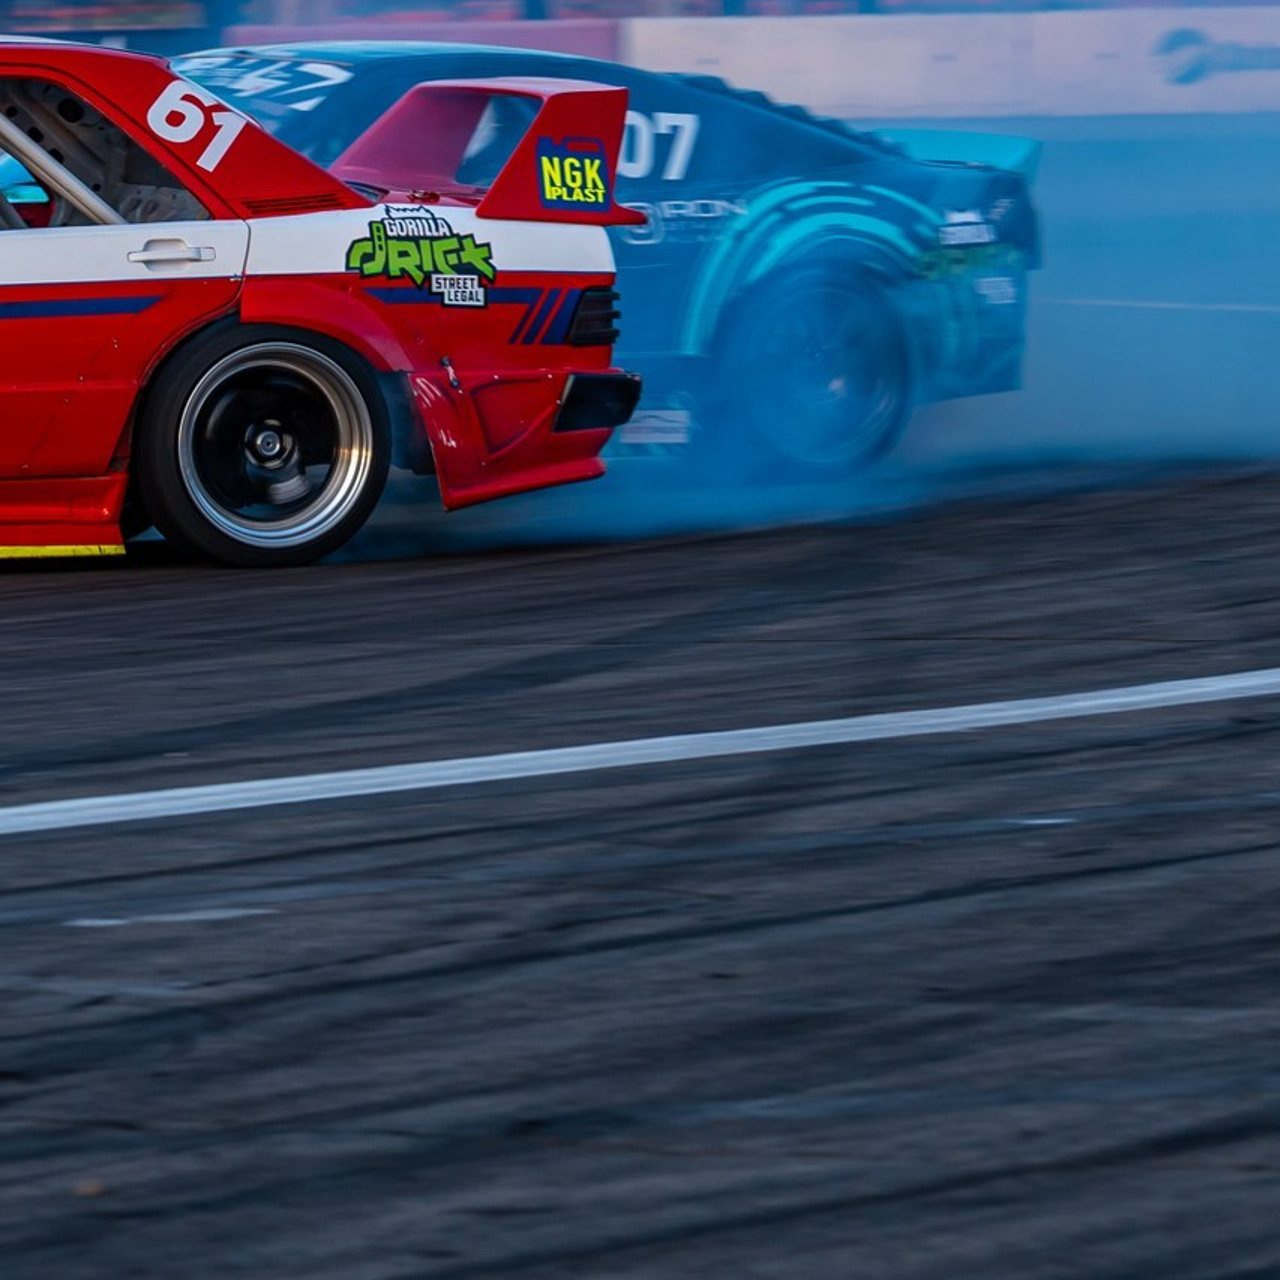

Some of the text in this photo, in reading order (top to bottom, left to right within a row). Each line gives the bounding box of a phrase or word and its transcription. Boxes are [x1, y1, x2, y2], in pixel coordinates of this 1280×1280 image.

[147, 79, 248, 173] 61
[541, 156, 604, 190] NGK
[546, 186, 606, 203] PLAST
[384, 219, 451, 237] GORILLA
[435, 277, 476, 290] STREET
[447, 290, 482, 303] LEGAL
